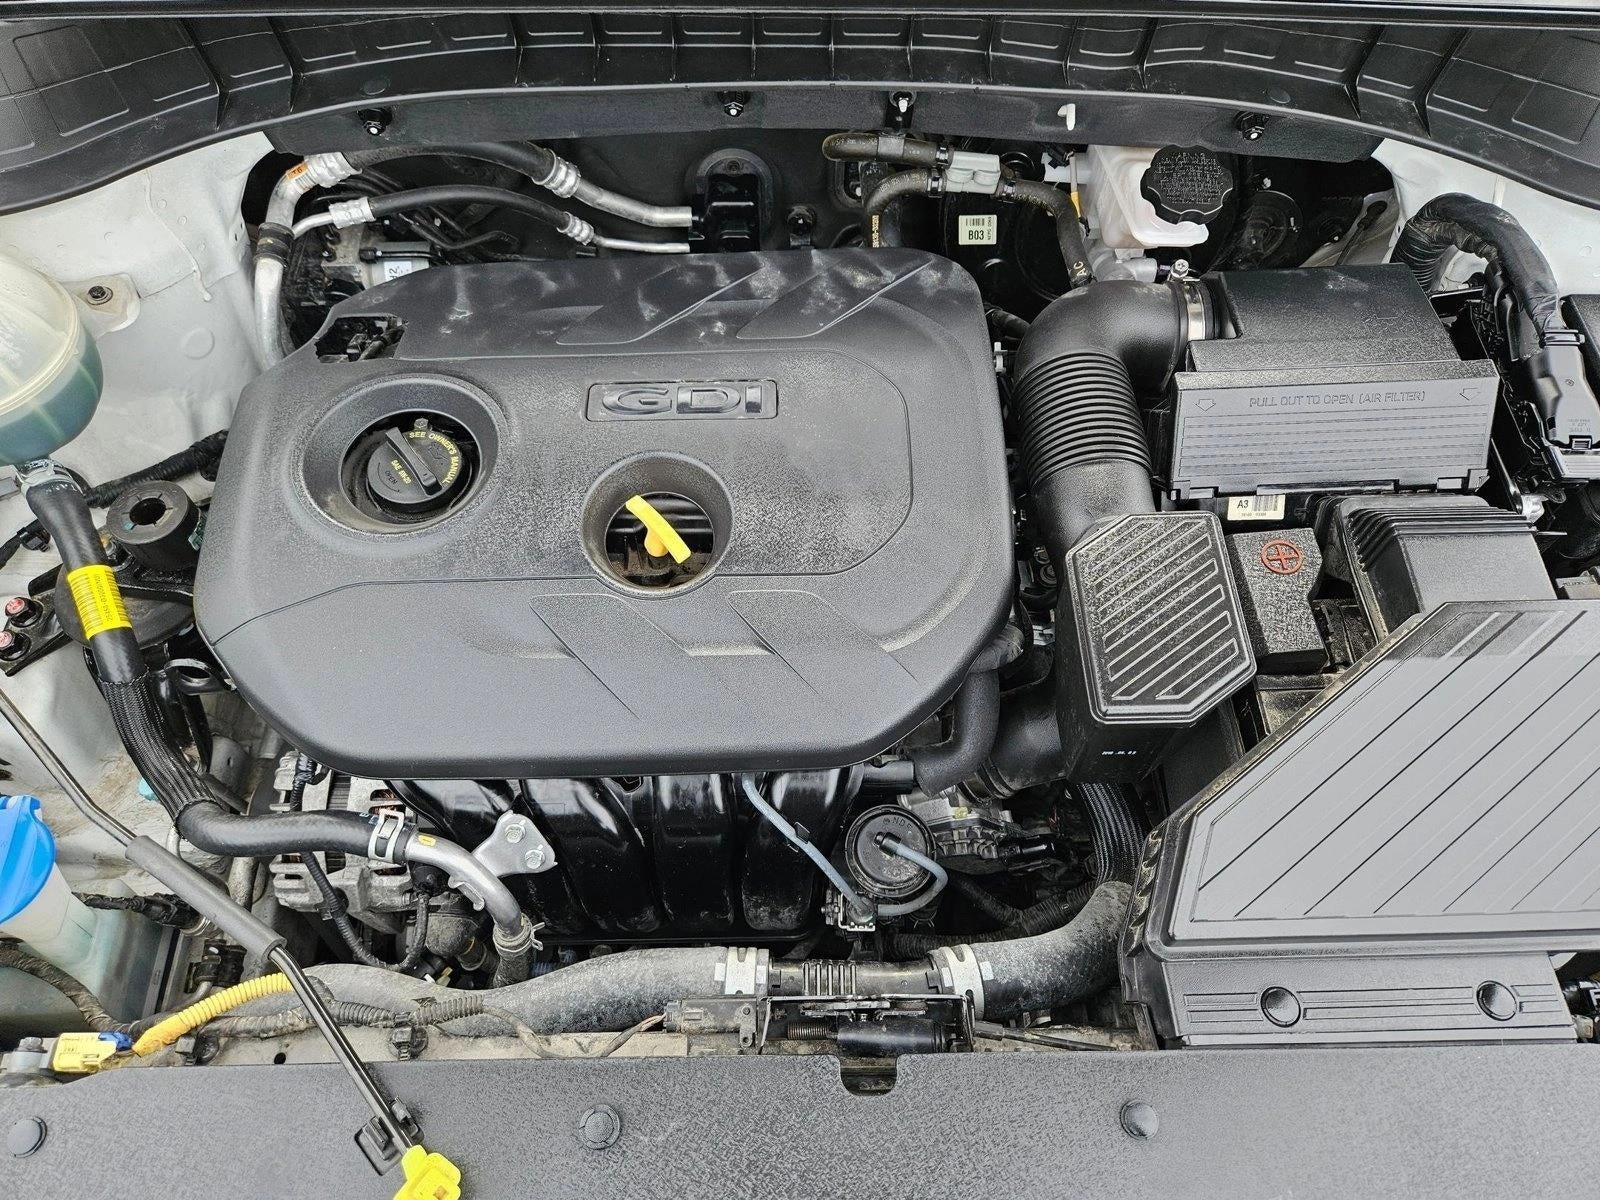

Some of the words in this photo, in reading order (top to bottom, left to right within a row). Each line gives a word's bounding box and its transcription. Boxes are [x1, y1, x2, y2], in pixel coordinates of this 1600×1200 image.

[968, 229, 985, 241] B03
[1073, 260, 1087, 277] AC
[602, 386, 763, 415] GDI
[1249, 397, 1278, 408] PULL
[1280, 395, 1303, 407] OUT
[1306, 394, 1321, 406] TO
[1323, 393, 1354, 405] OPEN
[1358, 392, 1382, 405] (AIR
[1384, 390, 1426, 403] FILTER)
[409, 431, 427, 439] SEE
[441, 456, 459, 485] MANUAL
[1236, 499, 1249, 509] A3
